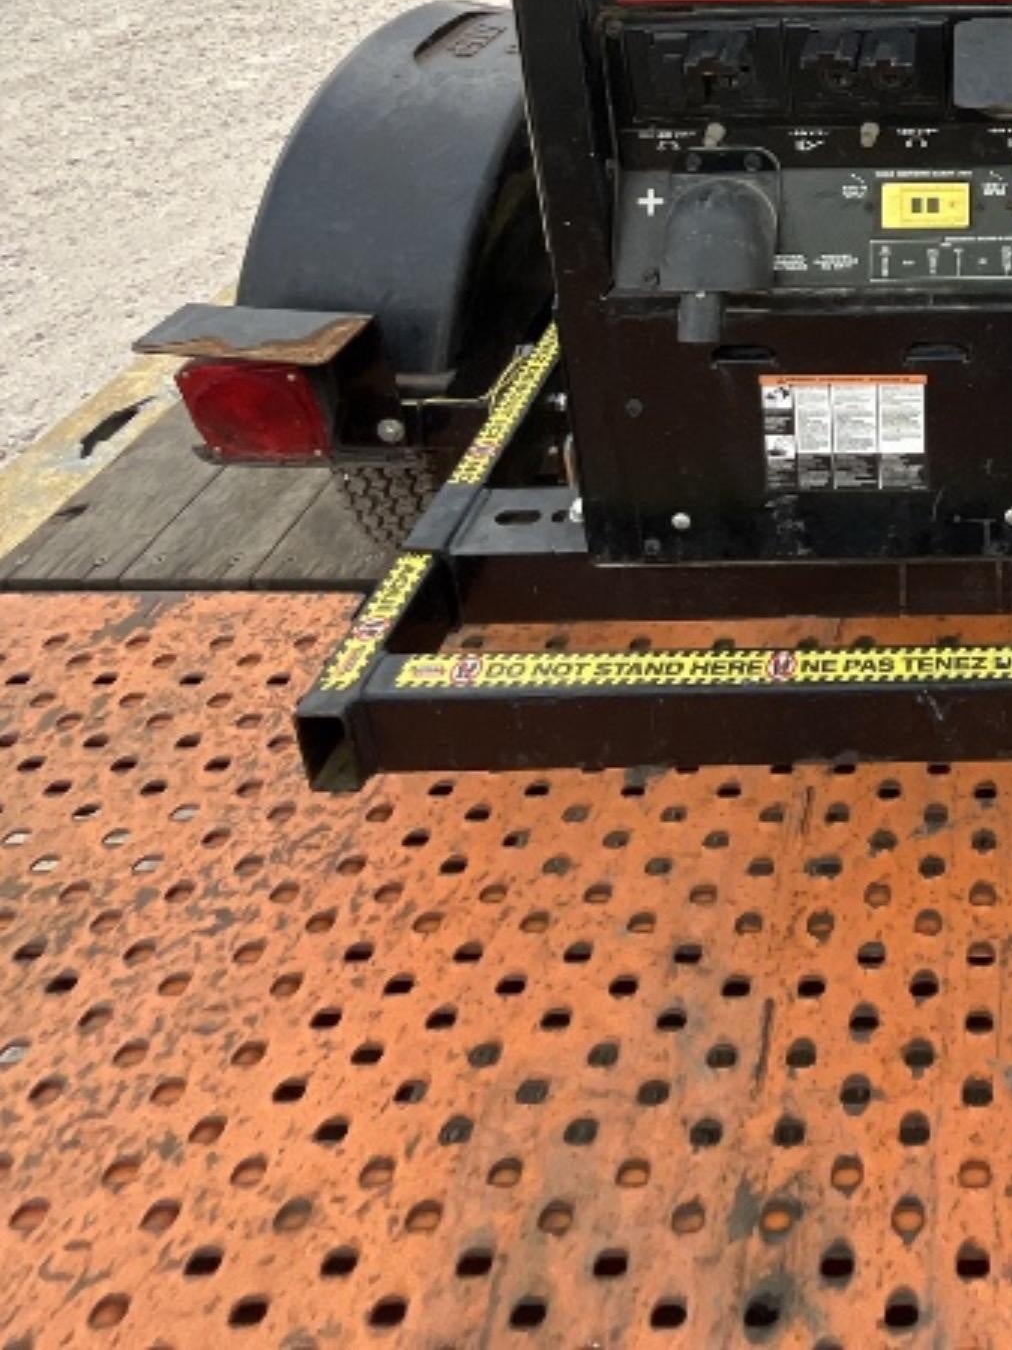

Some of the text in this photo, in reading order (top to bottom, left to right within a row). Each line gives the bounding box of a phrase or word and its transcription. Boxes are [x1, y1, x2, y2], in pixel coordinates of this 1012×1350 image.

[486, 658, 763, 677] DO NOT STAND HERE
[800, 656, 836, 673] NE
[843, 656, 895, 673] PAS
[905, 655, 988, 672] TENEZ
